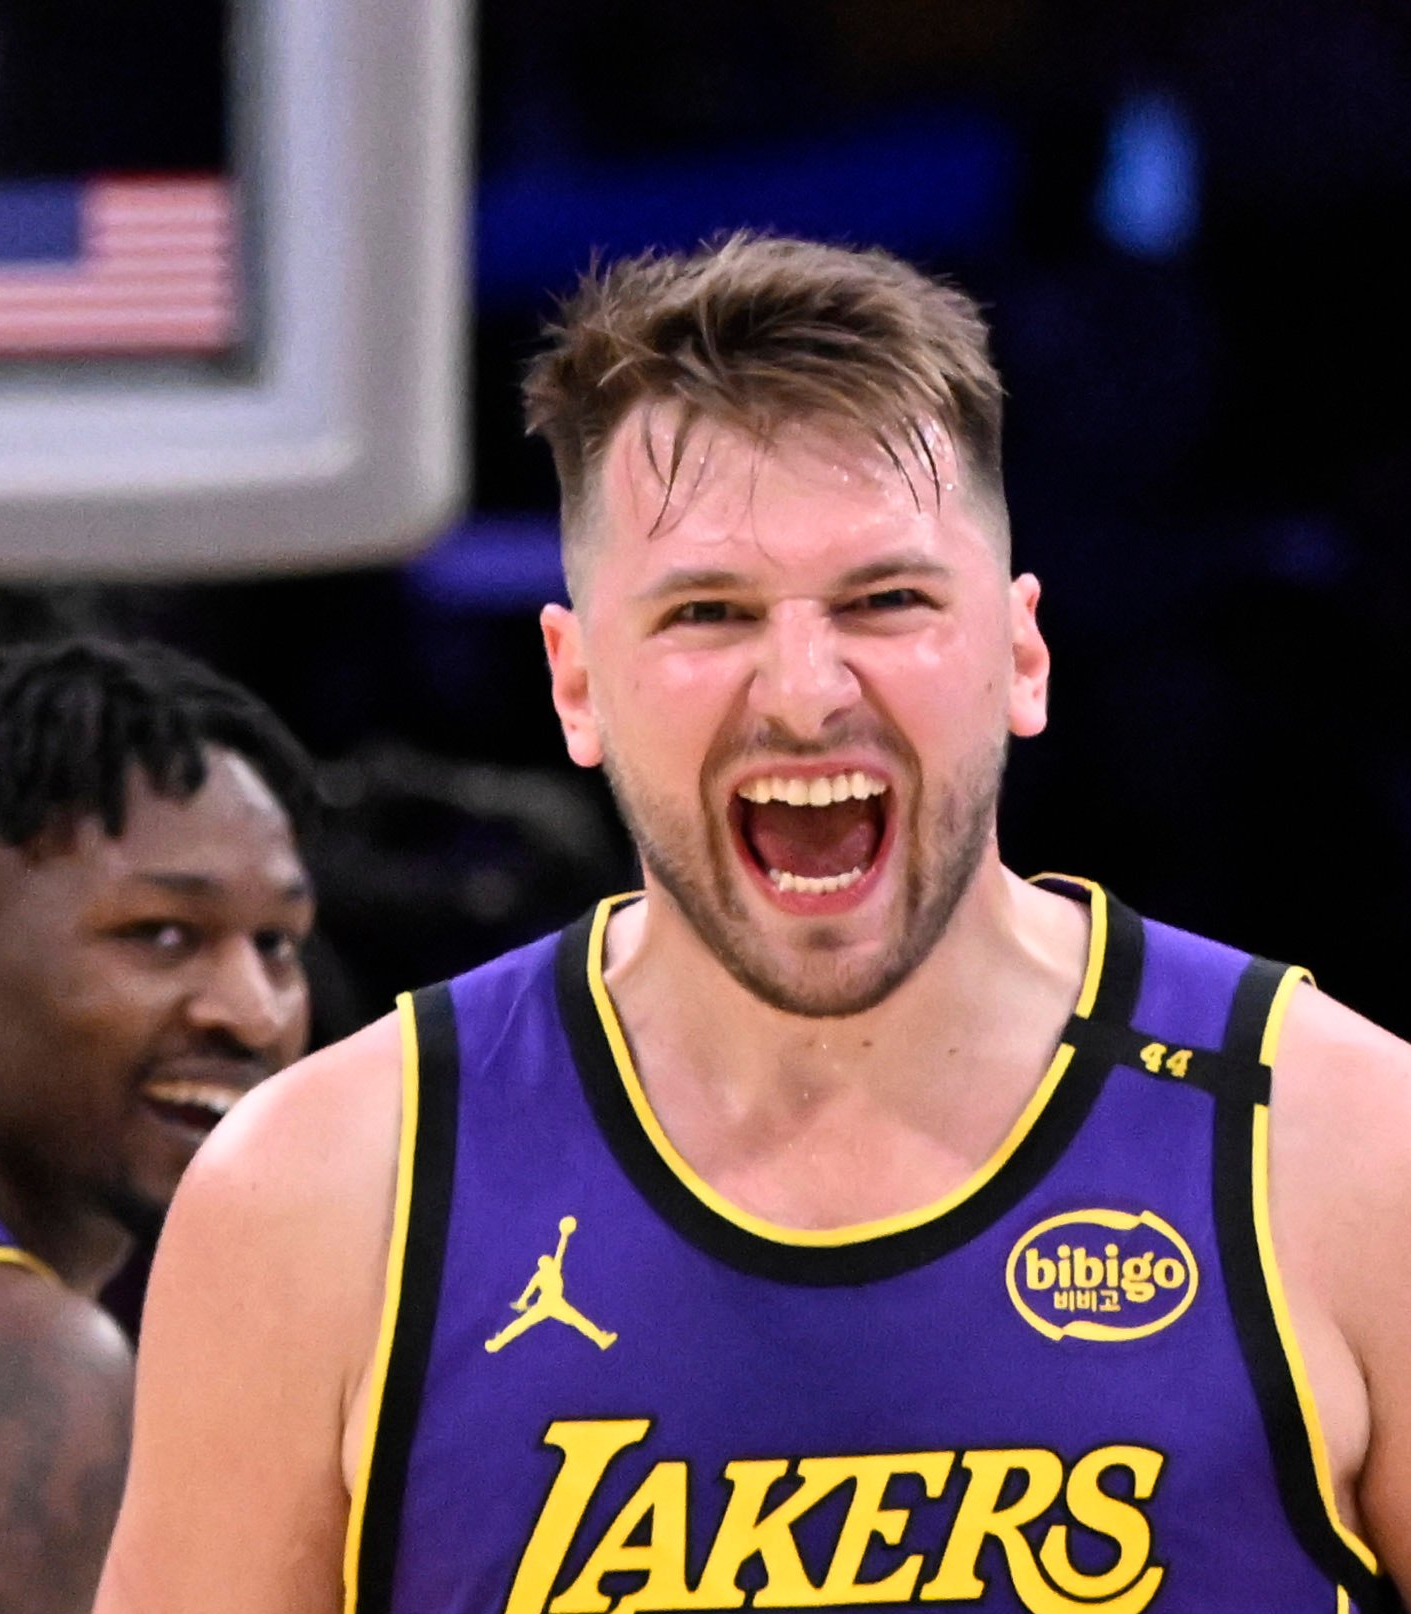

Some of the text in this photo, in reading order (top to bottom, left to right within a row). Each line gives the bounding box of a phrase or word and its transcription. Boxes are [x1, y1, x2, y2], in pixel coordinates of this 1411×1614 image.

[1139, 1042, 1193, 1078] 44
[1025, 1243, 1186, 1303] bibigo
[1053, 1290, 1122, 1312] 비비고
